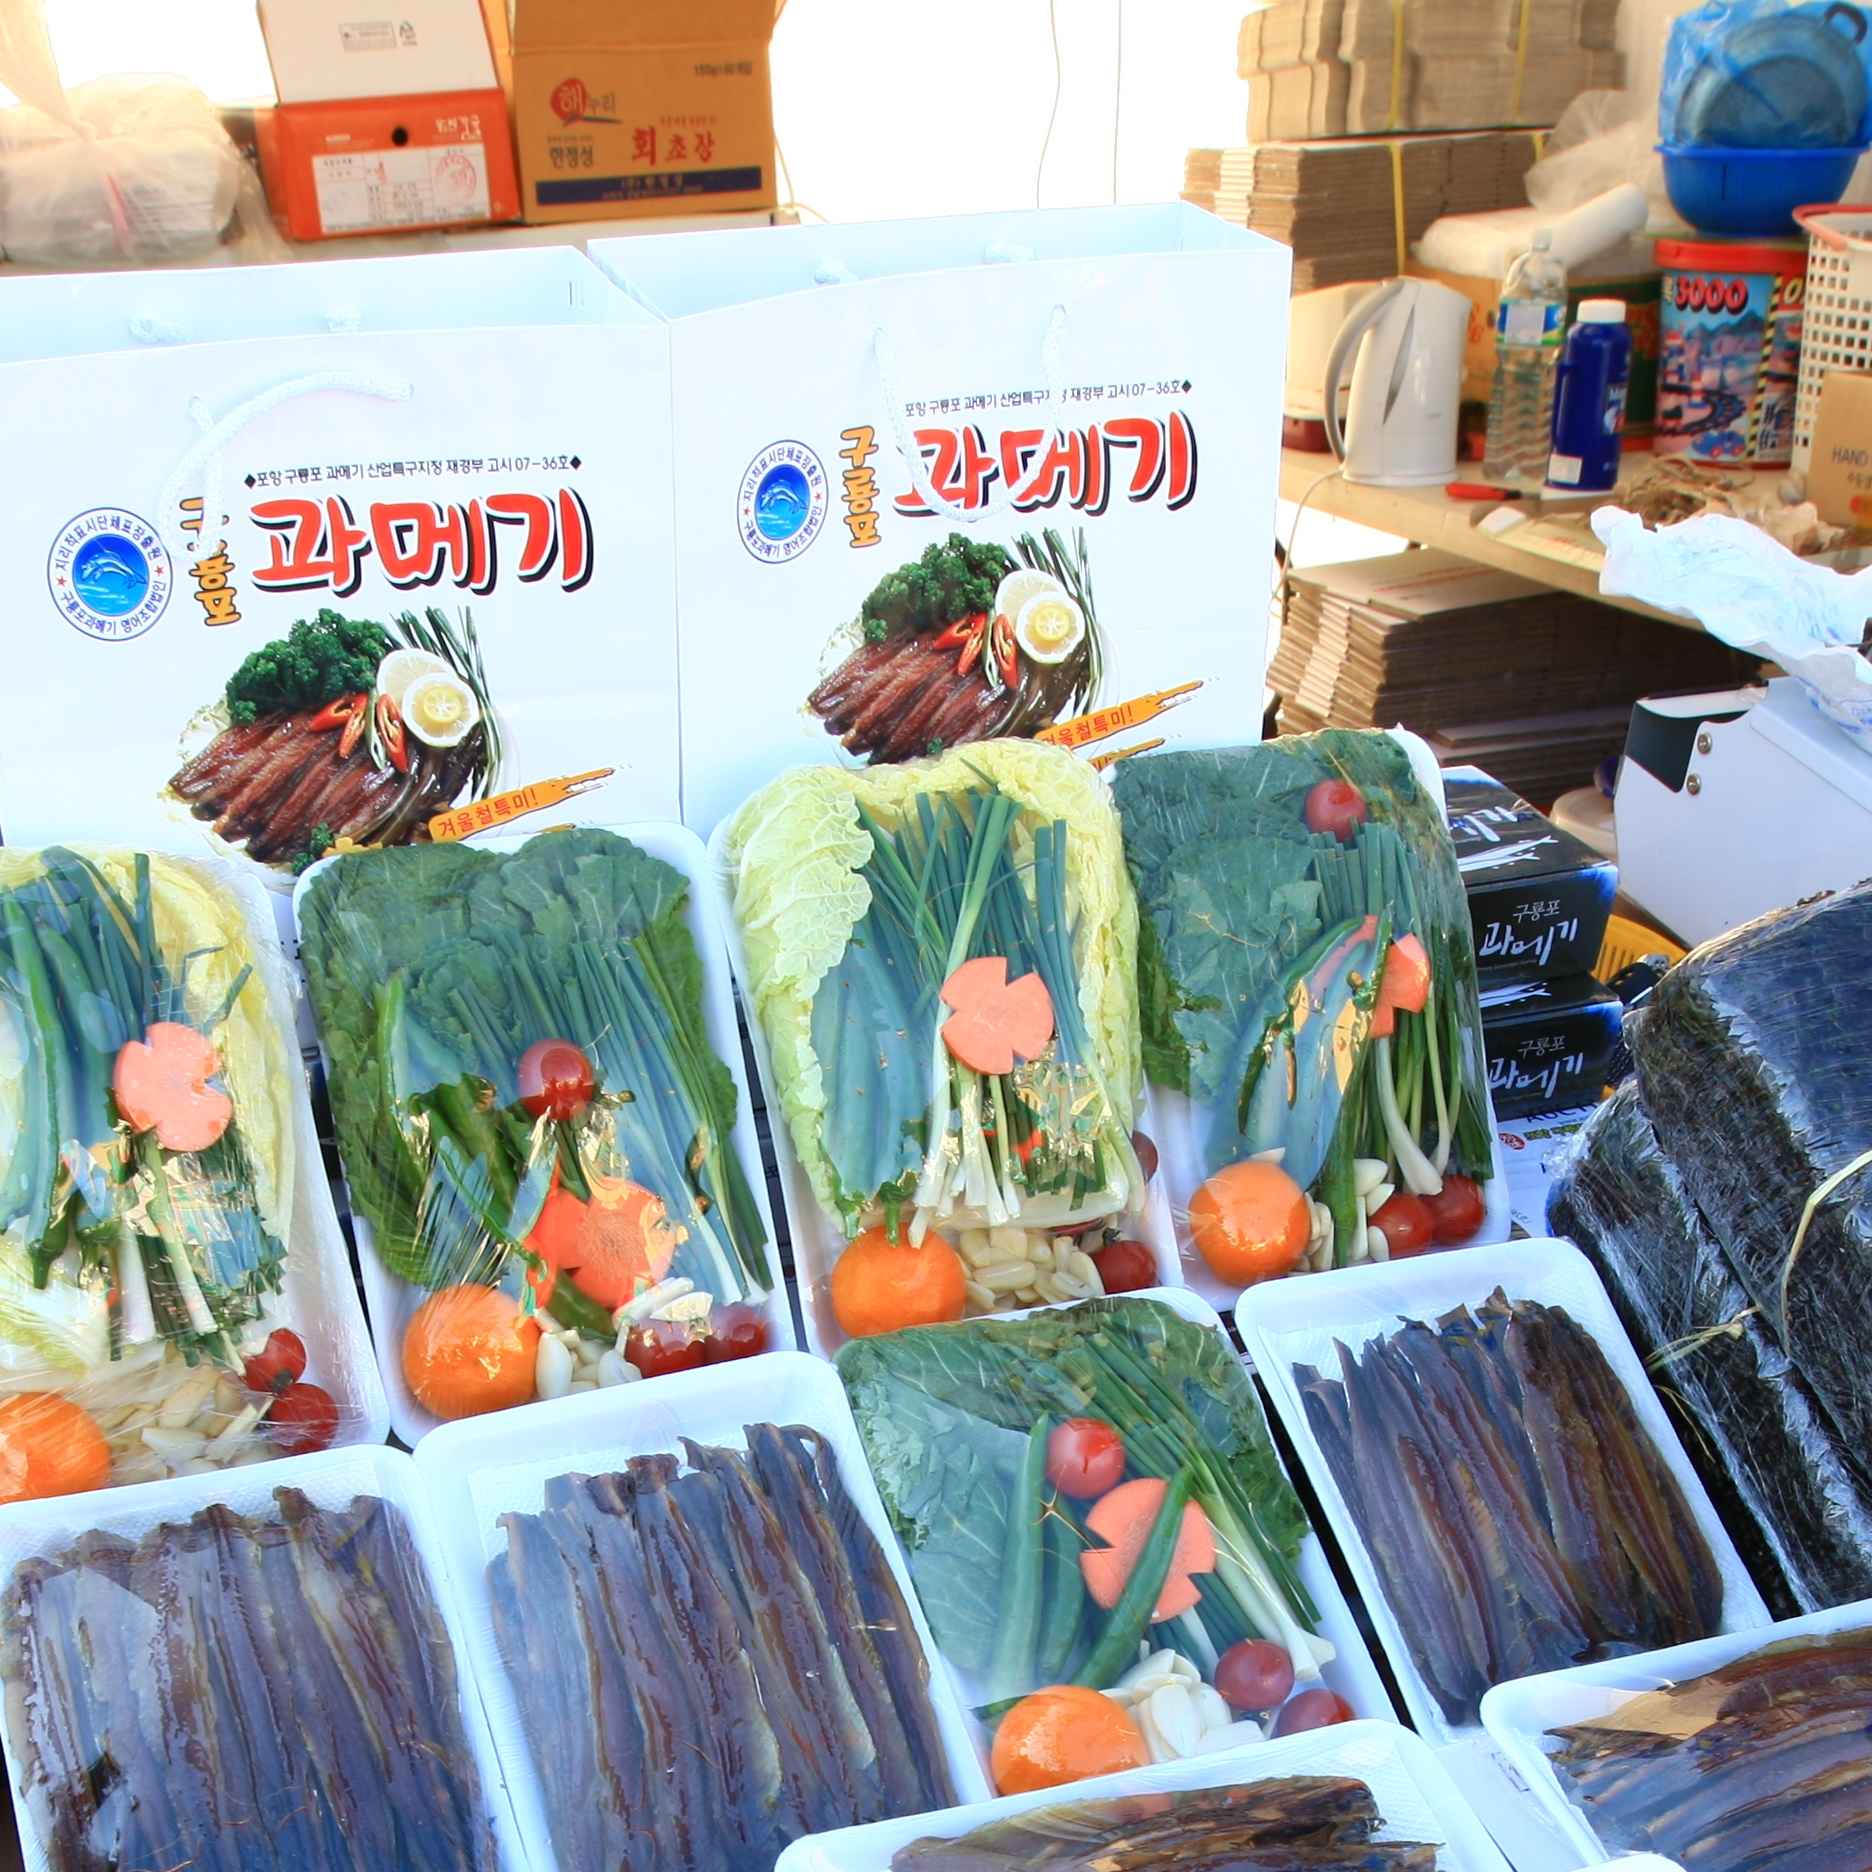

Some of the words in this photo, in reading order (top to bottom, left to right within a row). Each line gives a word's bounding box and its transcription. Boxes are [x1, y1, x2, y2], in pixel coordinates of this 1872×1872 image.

[840, 425, 883, 549] 구룡포
[892, 410, 1200, 517] 과메기
[1831, 448, 1867, 467] HAND
[248, 486, 594, 597] 과메기
[1478, 917, 1579, 967] 과메기
